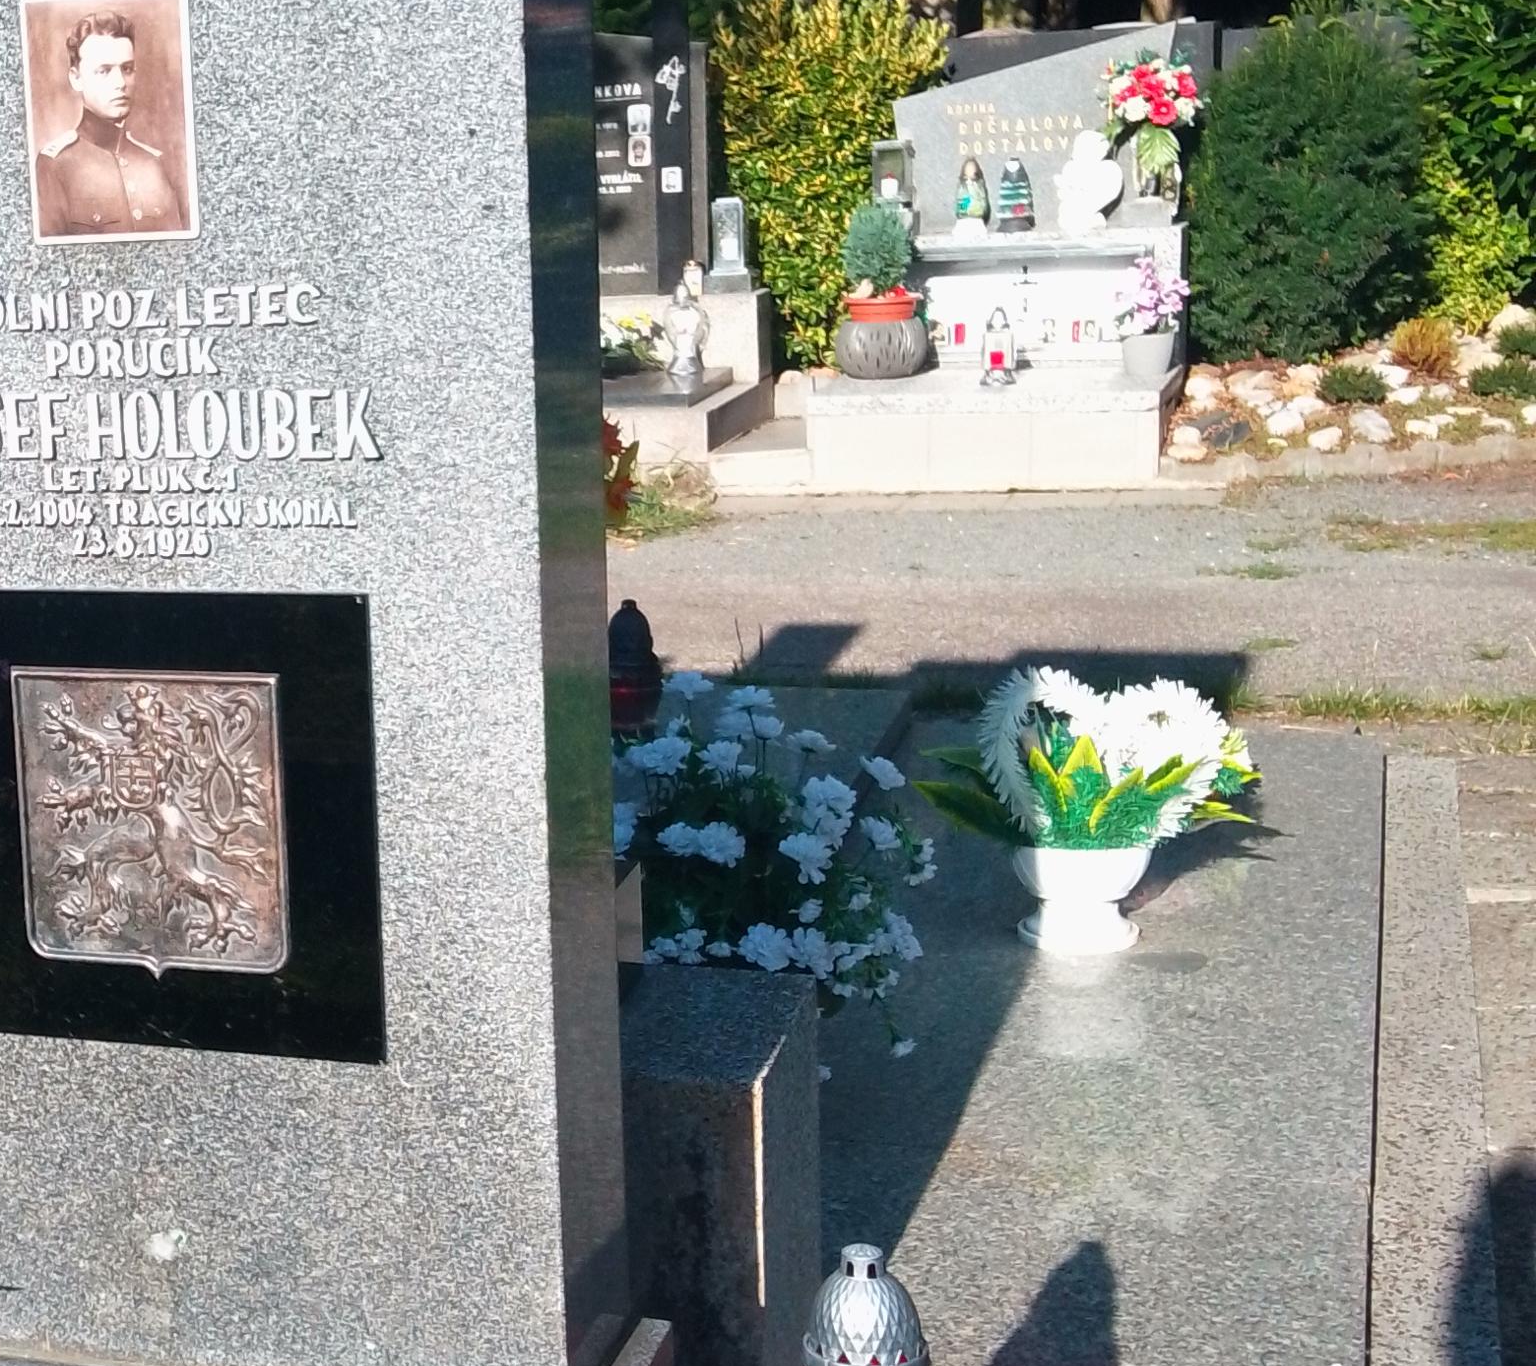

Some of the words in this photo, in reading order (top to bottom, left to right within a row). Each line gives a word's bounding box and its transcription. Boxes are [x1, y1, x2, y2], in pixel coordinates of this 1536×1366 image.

[594, 82, 642, 99] NKOVA
[958, 132, 1070, 155] DOSTÁLOV
[81, 289, 168, 332] POZ.
[176, 283, 322, 328] LETEC
[44, 327, 221, 379] PORUČÍK
[86, 387, 384, 463] HOLOUBEK
[105, 496, 244, 528] TRAGICKY
